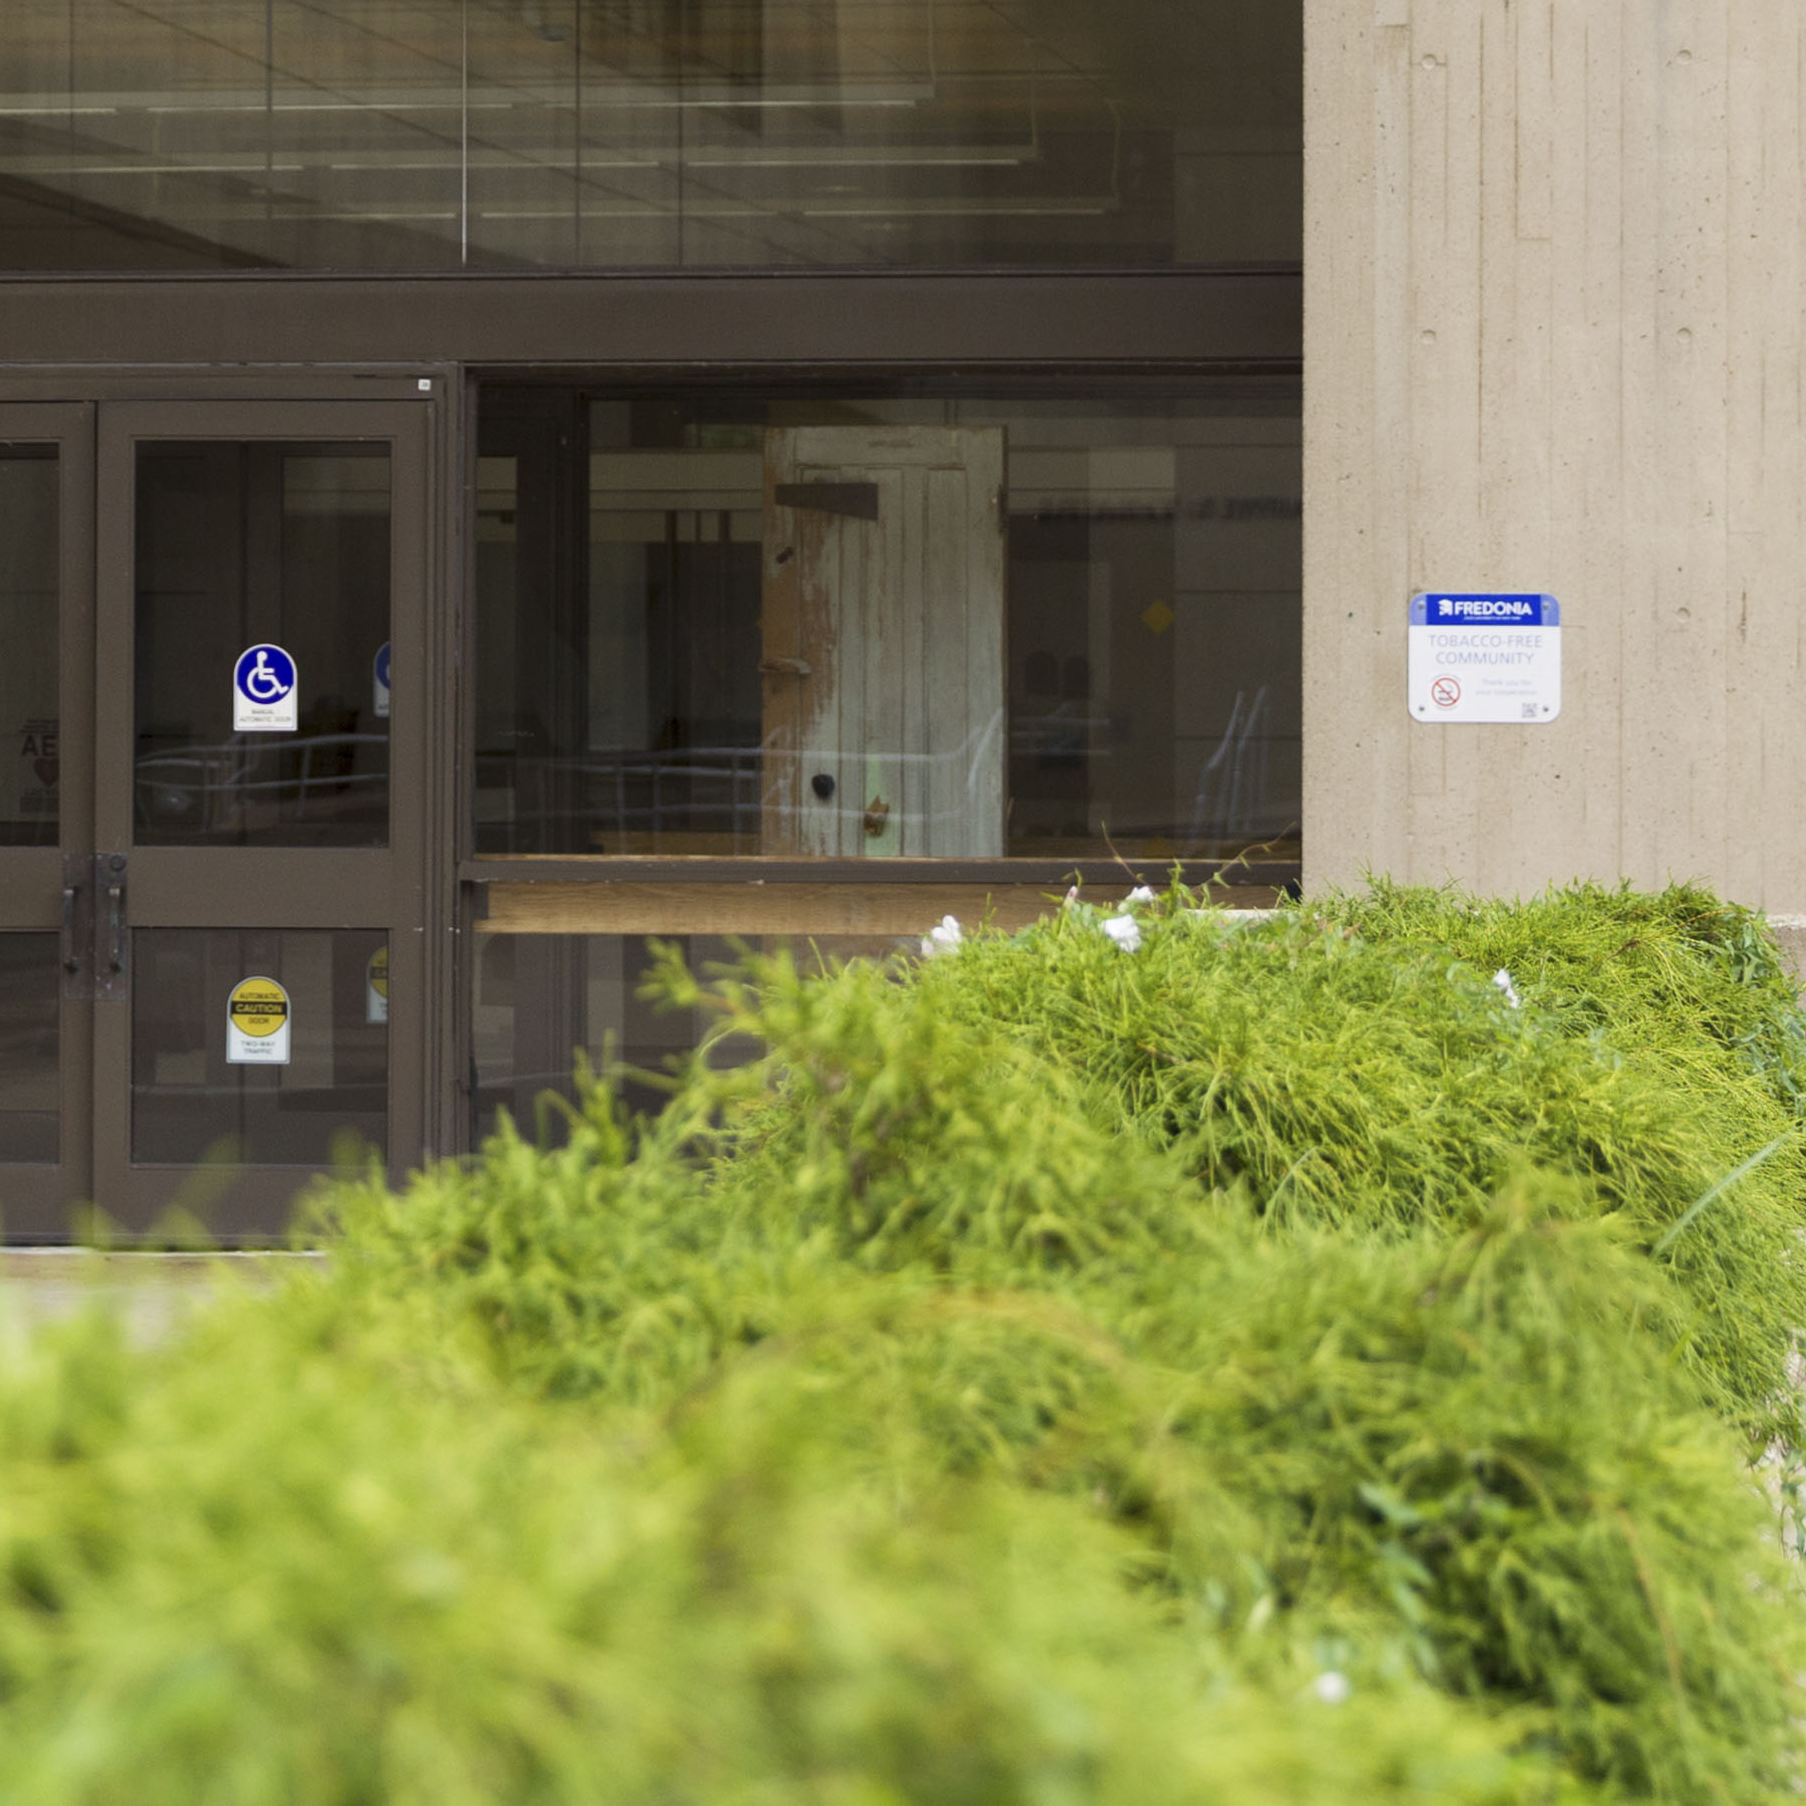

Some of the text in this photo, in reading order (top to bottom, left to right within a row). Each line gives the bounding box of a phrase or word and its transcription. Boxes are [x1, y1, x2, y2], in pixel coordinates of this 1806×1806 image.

[1454, 601, 1533, 616] FREDONIA
[1428, 634, 1542, 648] TOBACCO-FREE
[1435, 651, 1535, 665] COMMUNITY
[21, 735, 57, 756] AE
[235, 1004, 283, 1013] CAUTION
